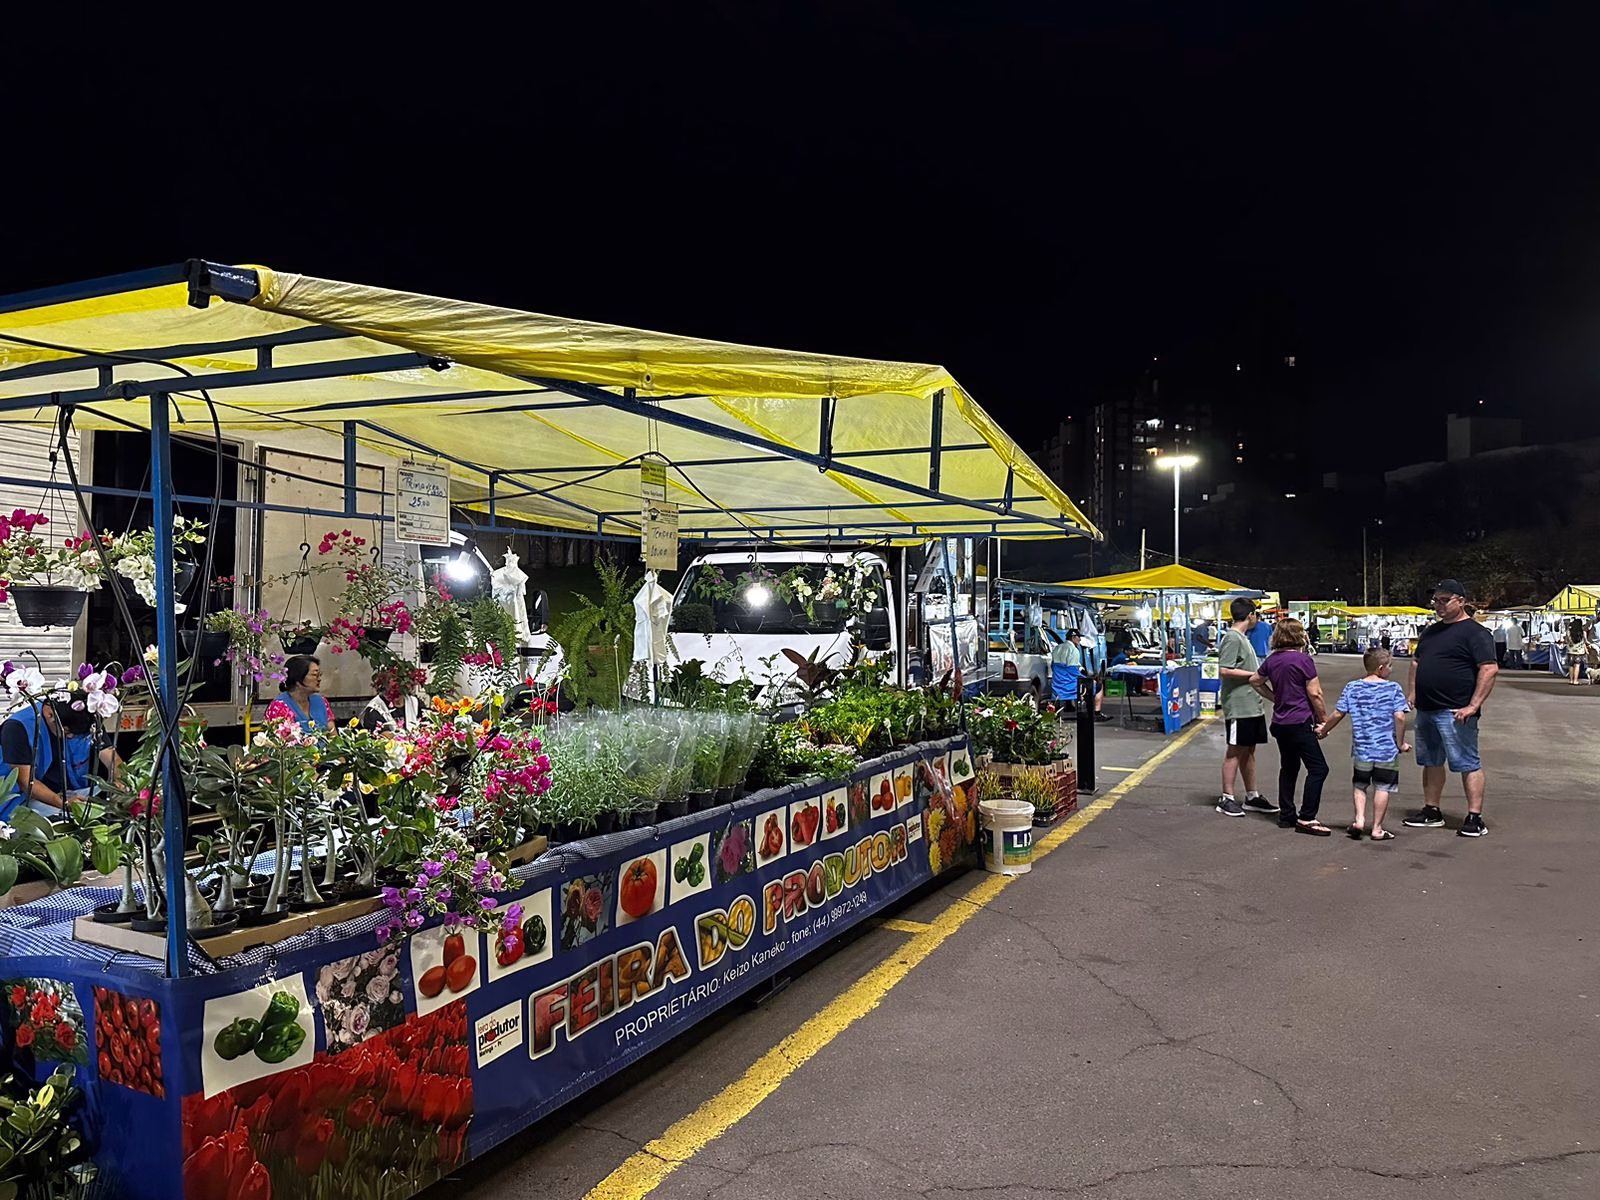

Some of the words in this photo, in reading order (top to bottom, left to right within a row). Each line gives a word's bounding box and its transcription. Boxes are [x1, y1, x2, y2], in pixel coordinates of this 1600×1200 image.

[529, 925, 691, 1060] FEIRA
[694, 895, 756, 971] DO
[763, 823, 908, 935] PRODUTOR
[615, 977, 721, 1047] PROPRIETÁRIO:
[722, 961, 750, 985] Keizo
[751, 941, 786, 968] Kaneko
[812, 914, 830, 934] (44)
